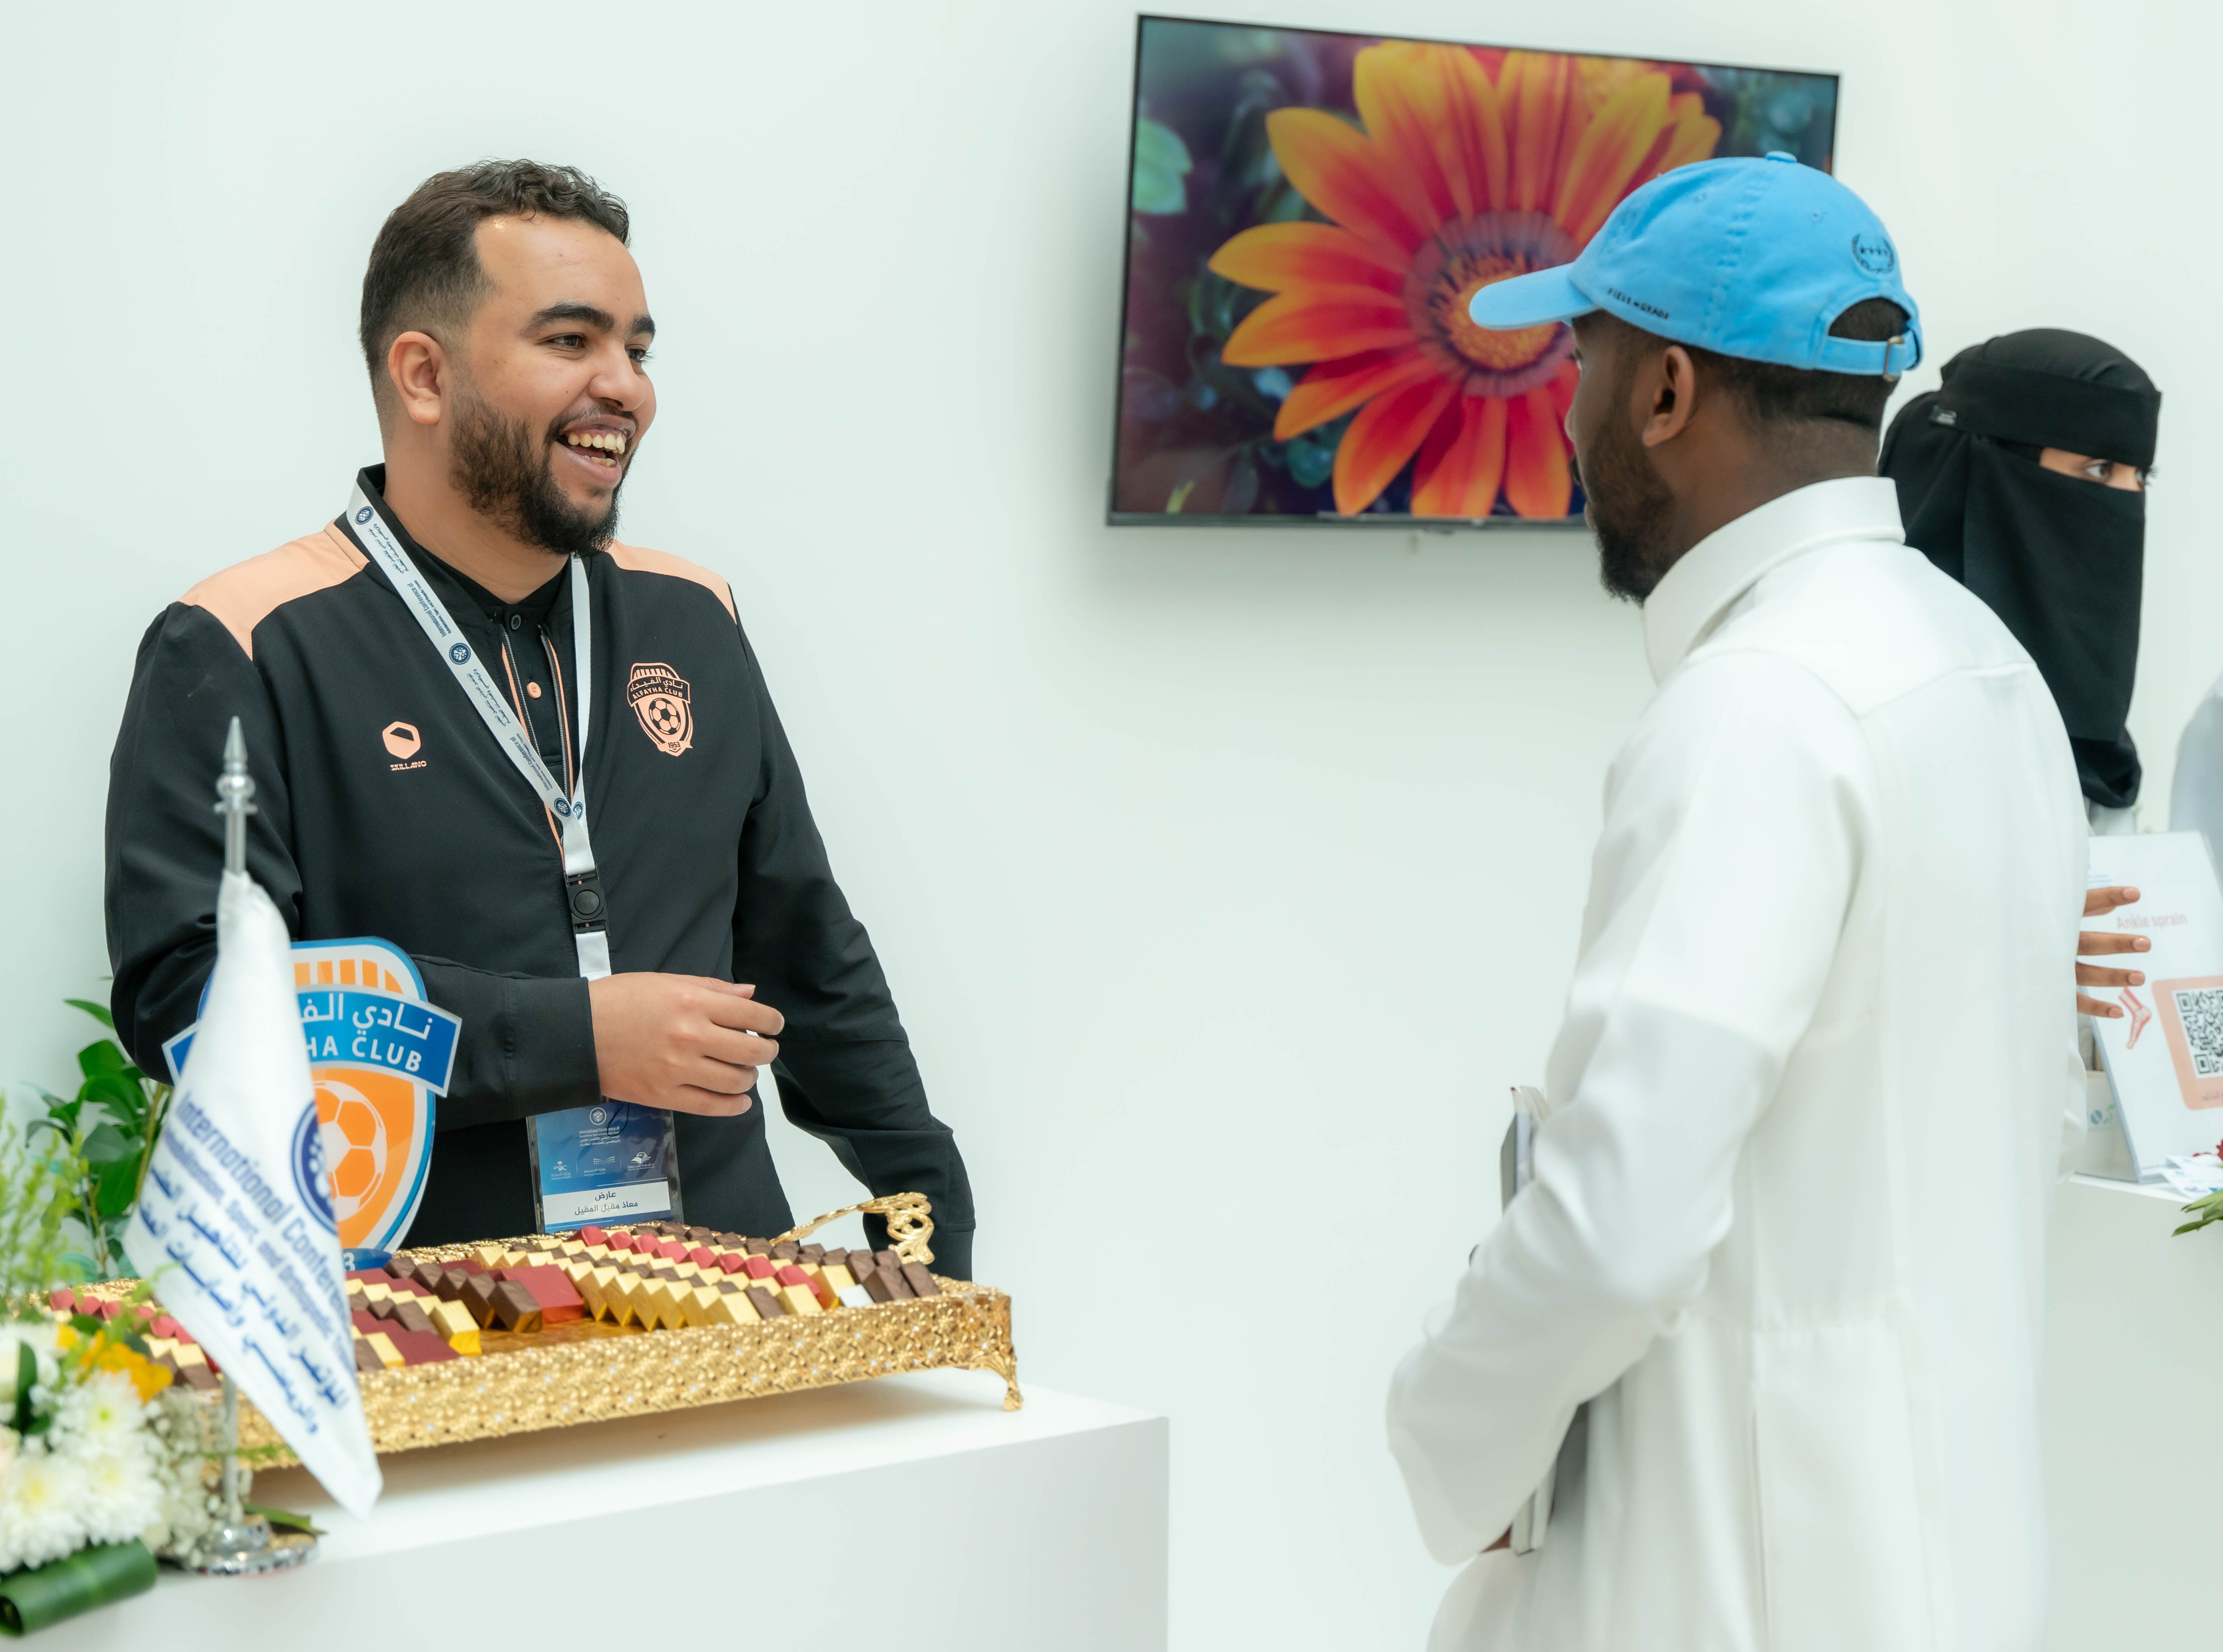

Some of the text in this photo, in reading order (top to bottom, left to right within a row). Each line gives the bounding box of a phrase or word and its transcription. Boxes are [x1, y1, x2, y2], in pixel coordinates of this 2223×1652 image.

[411, 587, 429, 611] Conference
[426, 610, 447, 637] International
[630, 676, 662, 692] الفيحاء
[632, 687, 683, 700] ALFAYHA CLUB
[514, 741, 532, 765] Conference
[530, 764, 550, 791] International
[2116, 912, 2188, 930] Ankle sprain
[352, 1002, 433, 1041] نادي
[352, 1036, 422, 1072] CLUB
[177, 1091, 295, 1225] International
[595, 1191, 616, 1201] عارض
[601, 1203, 619, 1212] مقيل
[575, 1205, 598, 1216] المقيل
